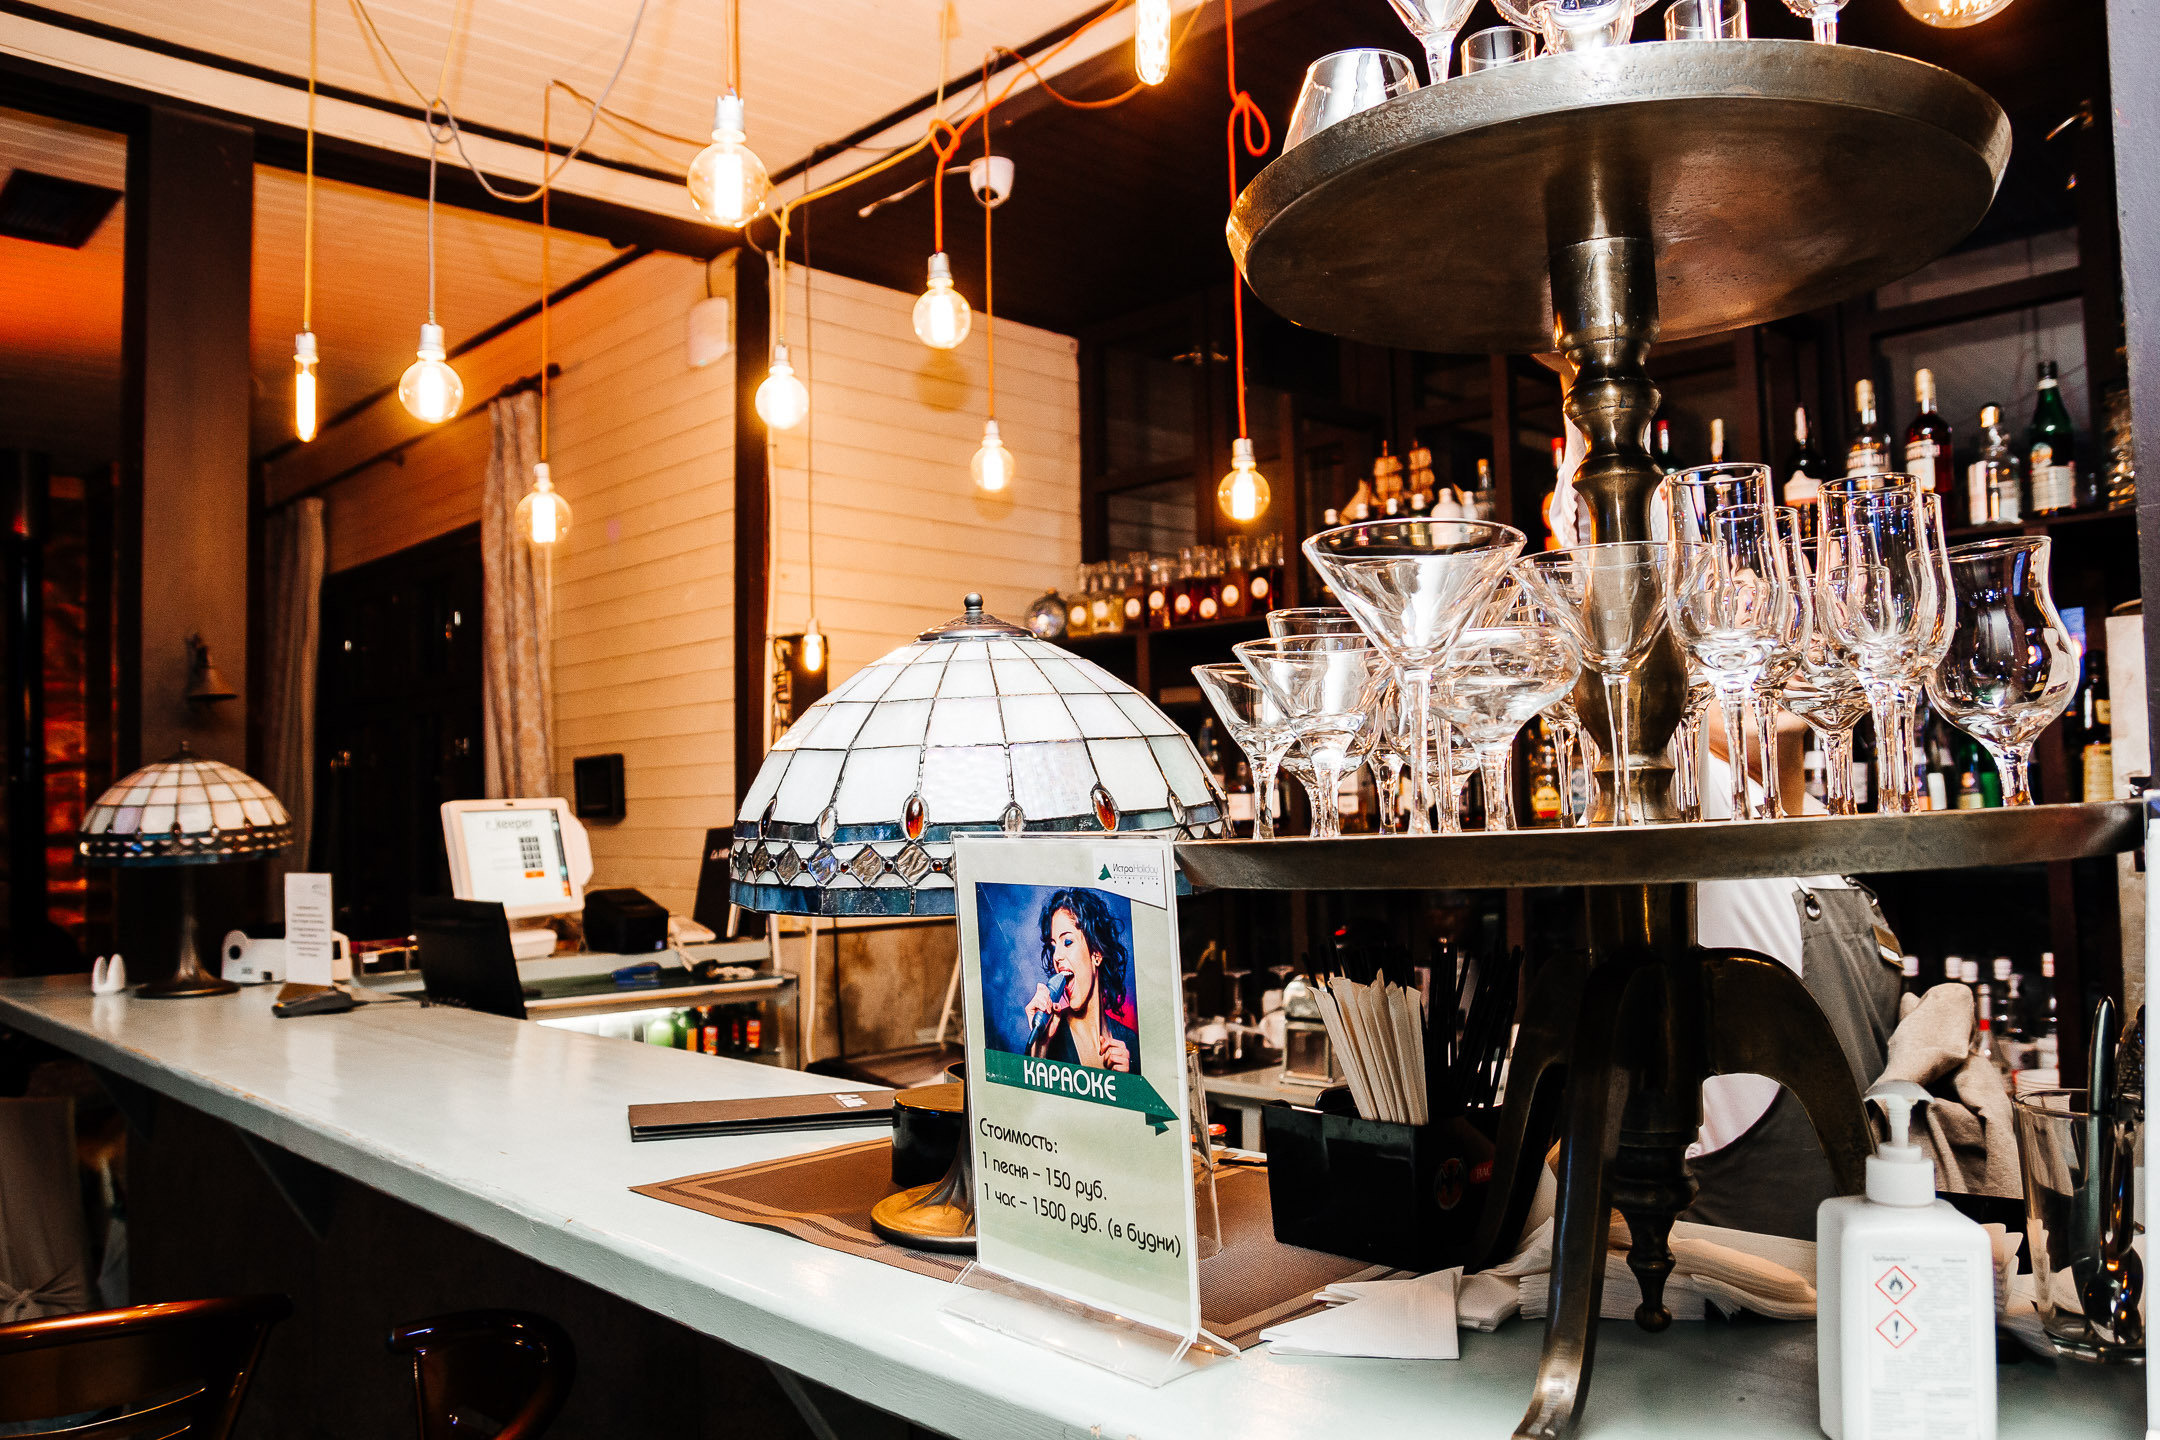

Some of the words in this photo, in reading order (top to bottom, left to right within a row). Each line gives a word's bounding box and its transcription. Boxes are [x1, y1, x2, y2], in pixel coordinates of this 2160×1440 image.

[1023, 1059, 1117, 1101] КАРАОКЕ
[979, 1117, 1058, 1153] Стоимость:
[982, 1151, 988, 1169] 1
[993, 1158, 1029, 1180] песня
[1045, 1167, 1071, 1191] 150
[1075, 1180, 1107, 1200] руб.
[984, 1183, 989, 1201] 1
[994, 1190, 1017, 1208] час
[1032, 1196, 1066, 1222] 1500
[1070, 1212, 1102, 1234] руб.
[1107, 1217, 1123, 1240] (в
[1126, 1222, 1181, 1258] будни)
